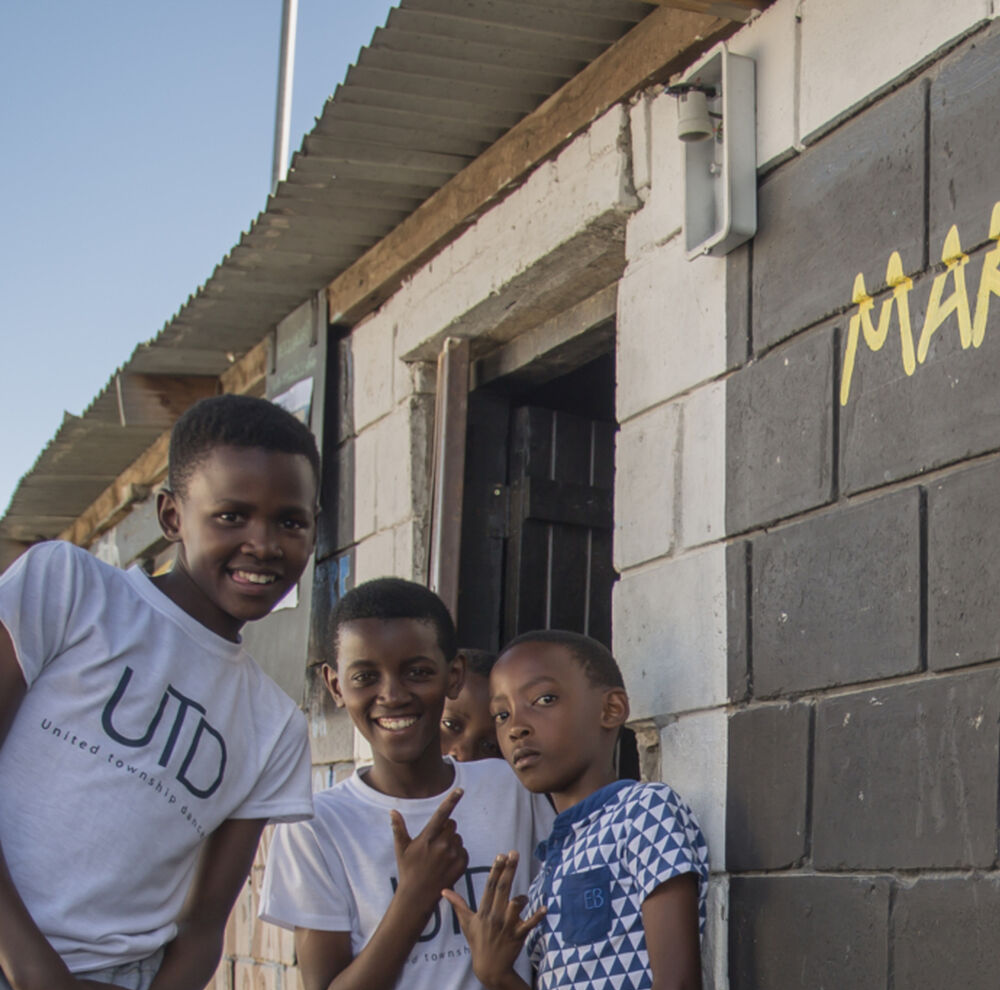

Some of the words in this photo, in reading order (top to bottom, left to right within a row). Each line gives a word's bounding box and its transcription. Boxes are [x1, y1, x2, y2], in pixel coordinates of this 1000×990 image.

[40, 718, 100, 755] United
[107, 753, 177, 804] township
[101, 666, 227, 799] UTD
